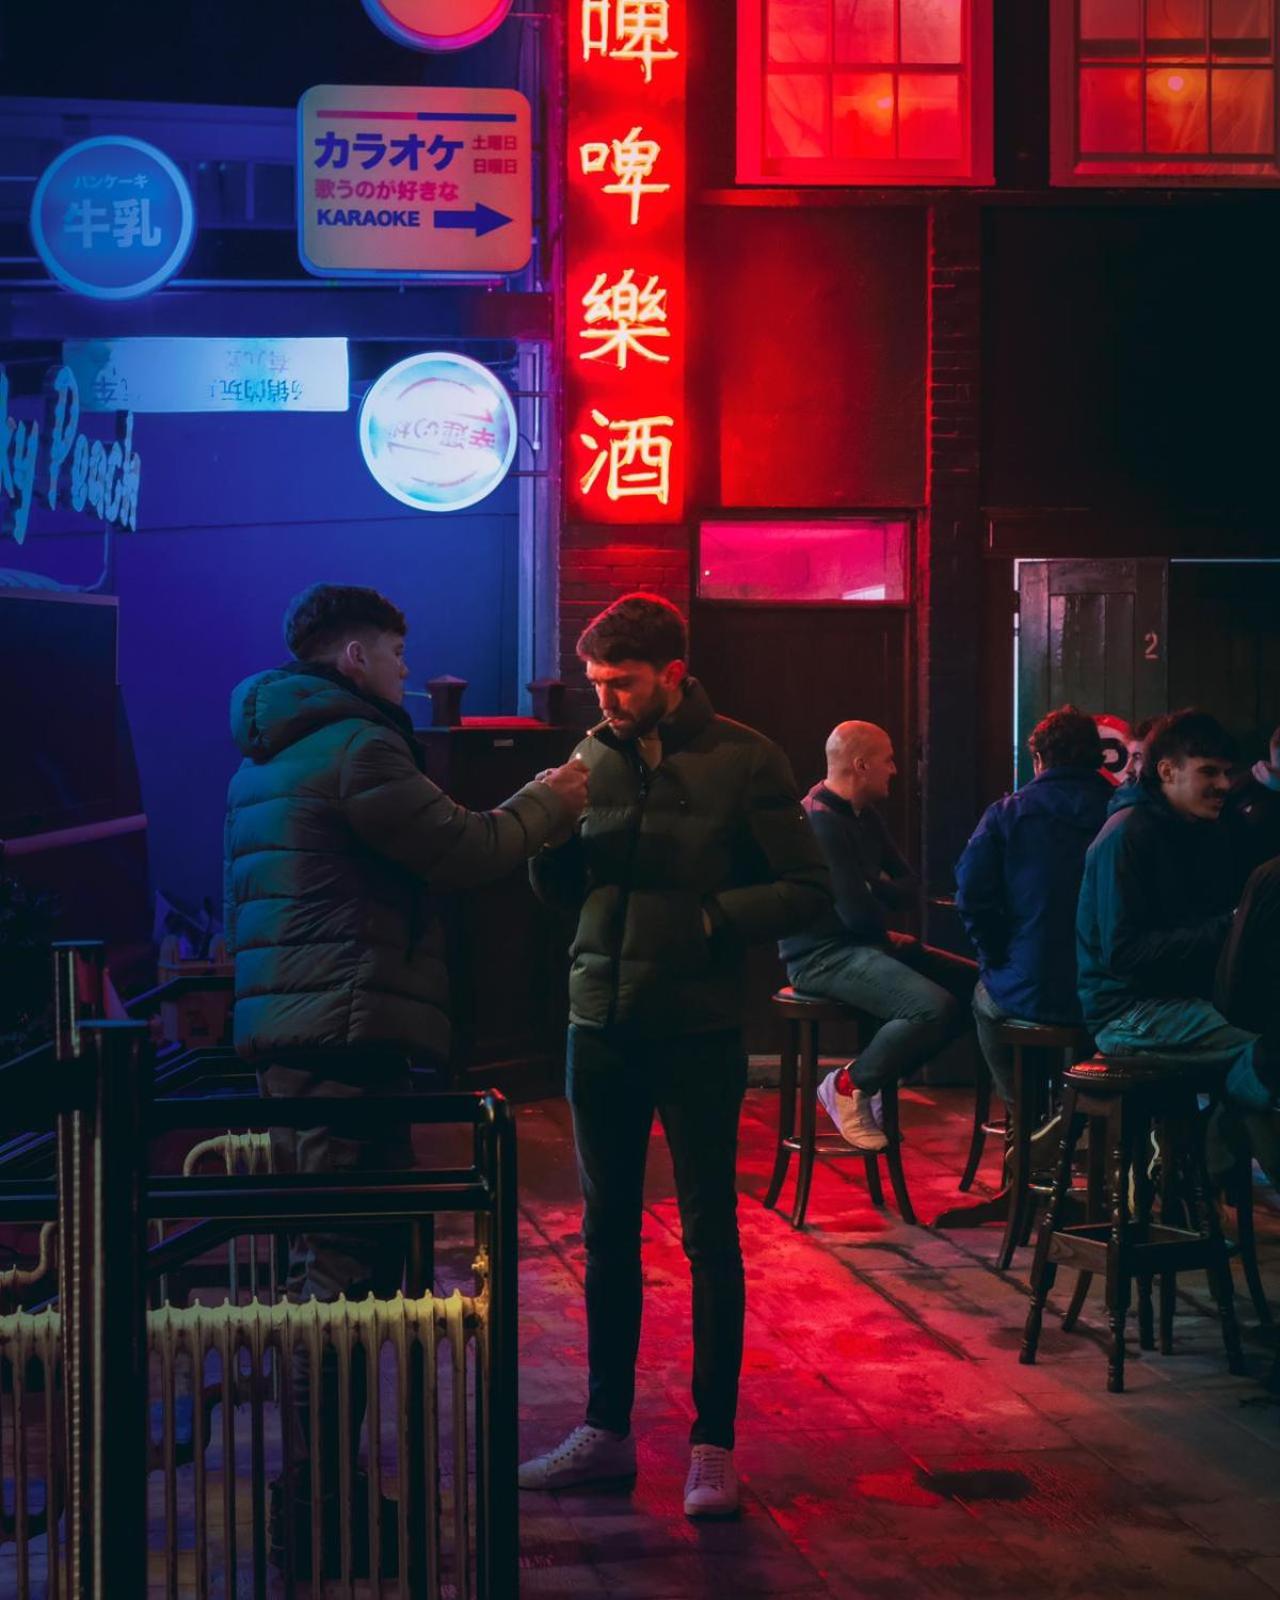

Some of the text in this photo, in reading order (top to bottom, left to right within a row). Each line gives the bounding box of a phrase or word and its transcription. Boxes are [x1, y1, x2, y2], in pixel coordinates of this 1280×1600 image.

[314, 131, 464, 171] カラオケ
[472, 135, 517, 151] 土曜日
[473, 159, 518, 174] 日曜日
[315, 178, 459, 202] 歌うのが好きな
[63, 198, 162, 249] 牛乳
[317, 209, 420, 227] KARAOKE
[48, 364, 141, 533] Peach
[1144, 632, 1158, 660] 2
